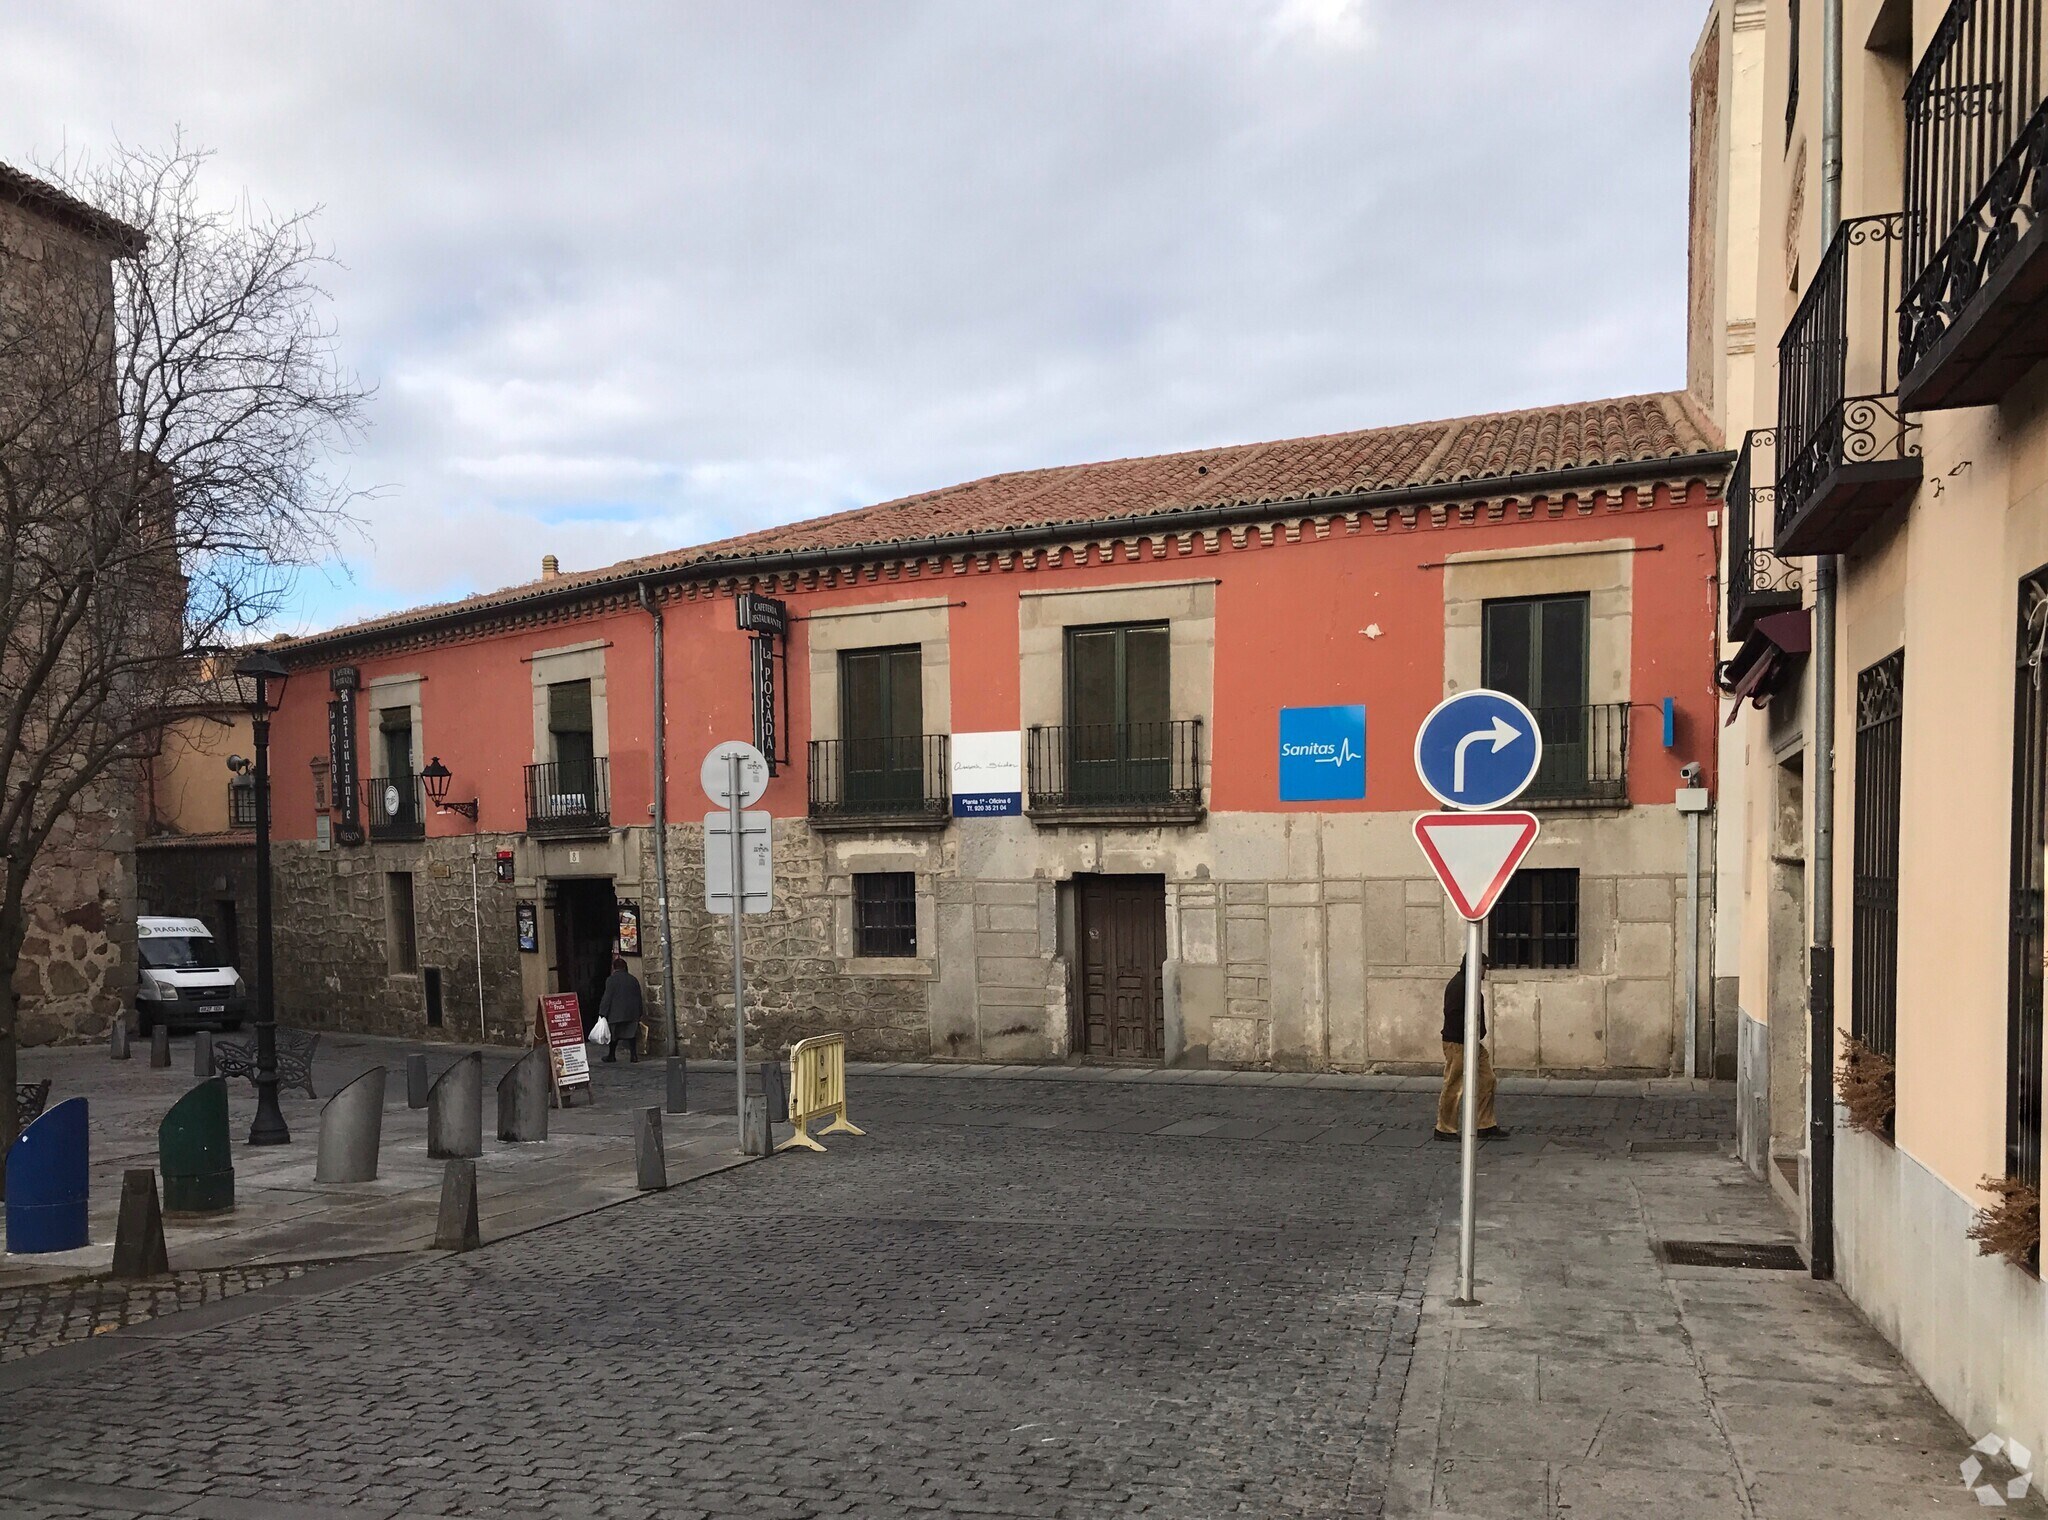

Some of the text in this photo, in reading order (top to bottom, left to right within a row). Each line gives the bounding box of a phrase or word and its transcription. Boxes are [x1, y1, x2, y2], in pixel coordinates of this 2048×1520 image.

[762, 647, 772, 660] La
[764, 667, 774, 750] POSADA
[330, 724, 338, 784] POSADA
[340, 689, 351, 820] Restaurante
[1281, 742, 1336, 757] Sanitas
[988, 797, 1007, 805] Oficina
